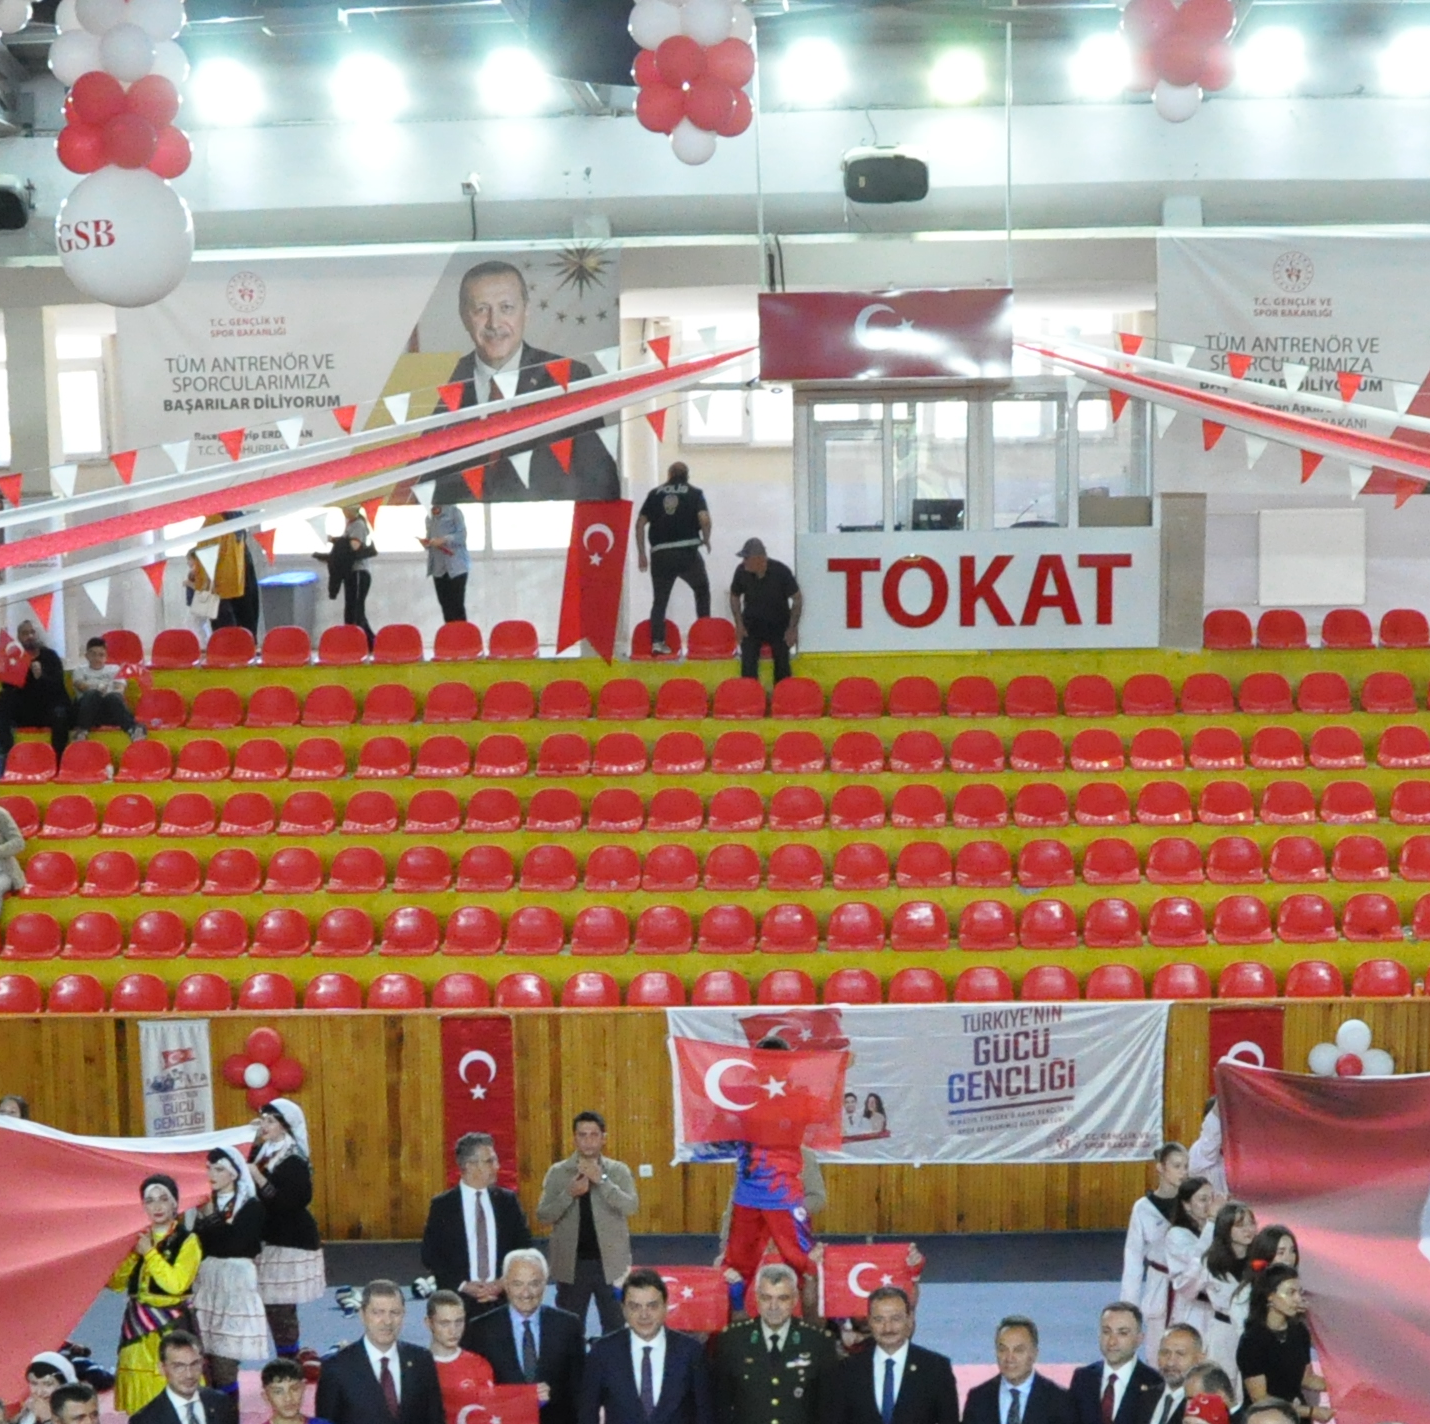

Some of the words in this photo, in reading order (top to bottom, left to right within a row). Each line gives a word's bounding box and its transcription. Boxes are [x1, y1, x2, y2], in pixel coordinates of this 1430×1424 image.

[57, 219, 116, 253] GSB
[1205, 332, 1247, 351] TÜM
[1251, 334, 1354, 353] ANTRENÖR
[1357, 336, 1380, 353] VE
[165, 354, 206, 373] TÜM
[211, 351, 309, 372] ANTRENÖR
[313, 353, 335, 370] VE
[172, 373, 331, 393] SPORCULARIMIZA
[163, 396, 251, 415] BAŞARILAR
[254, 394, 341, 410] DİLİYORUM
[827, 553, 1132, 629] TOKAT
[973, 1027, 1051, 1067] GÜCÜ
[947, 1057, 1075, 1104] GENÇLİĞİ
